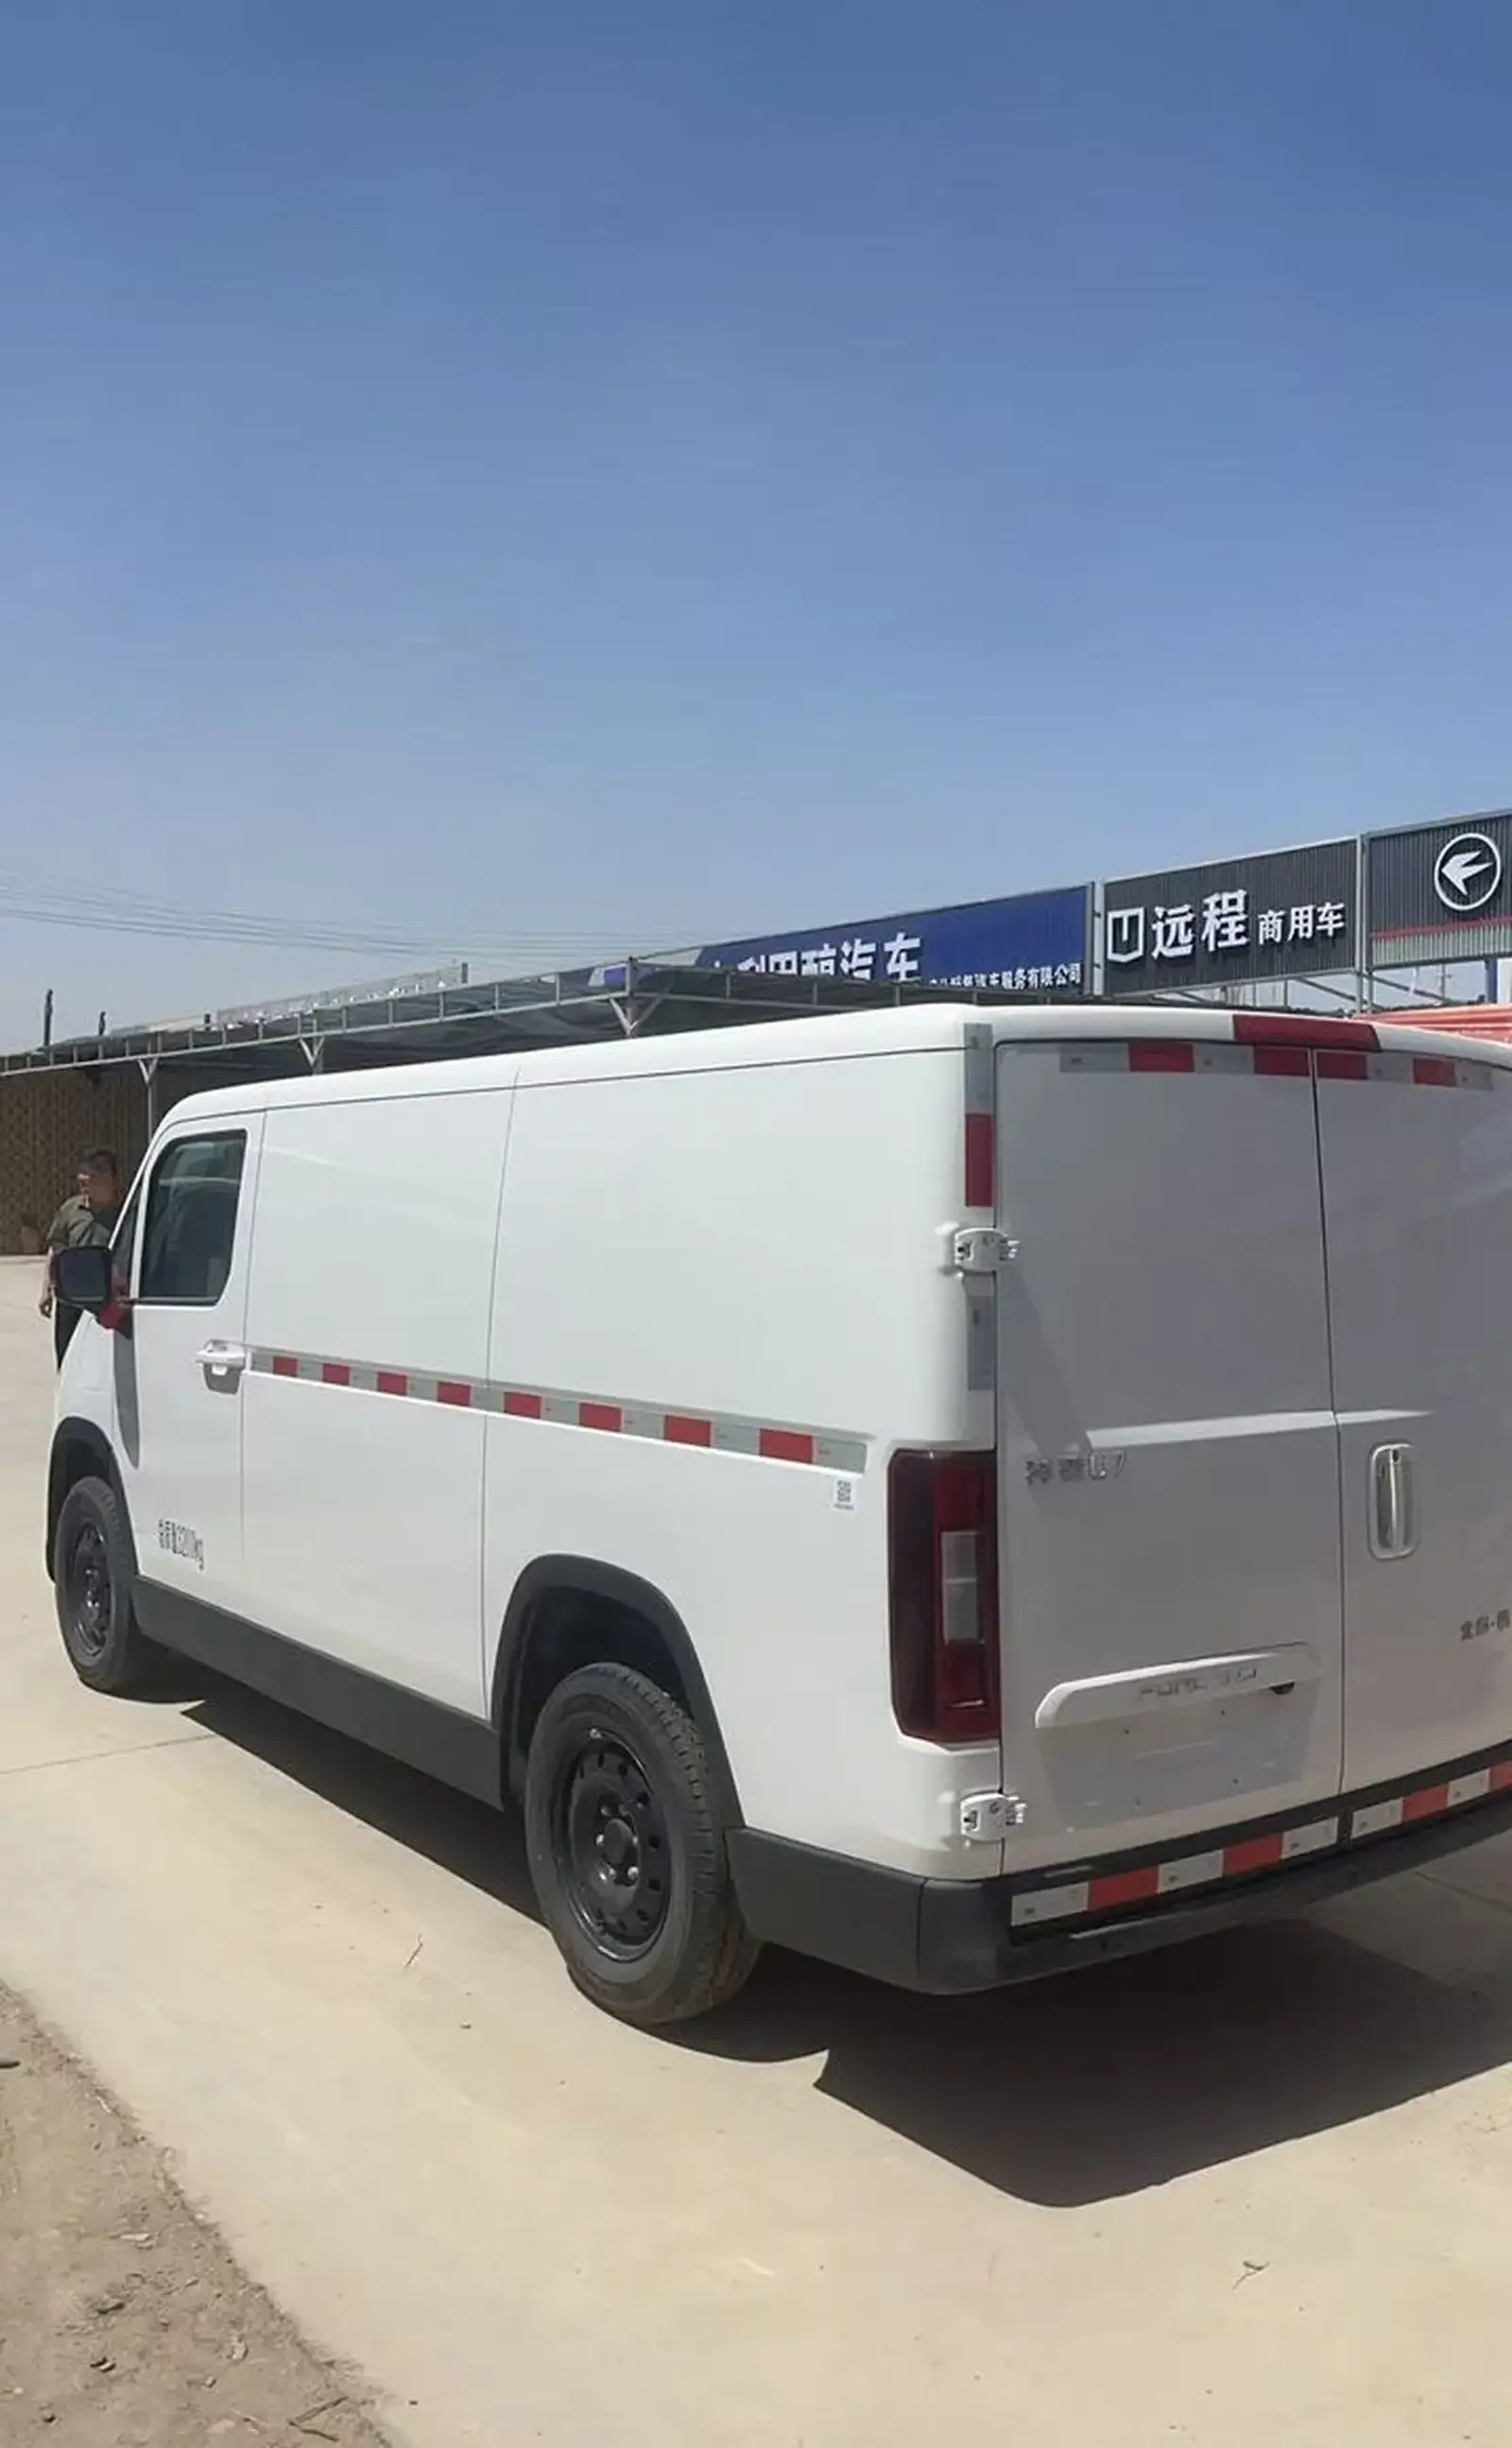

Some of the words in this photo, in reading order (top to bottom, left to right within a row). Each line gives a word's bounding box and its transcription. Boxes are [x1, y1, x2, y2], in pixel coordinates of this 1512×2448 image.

[1152, 889, 1249, 959] 远程
[1258, 902, 1345, 944] 商用车
